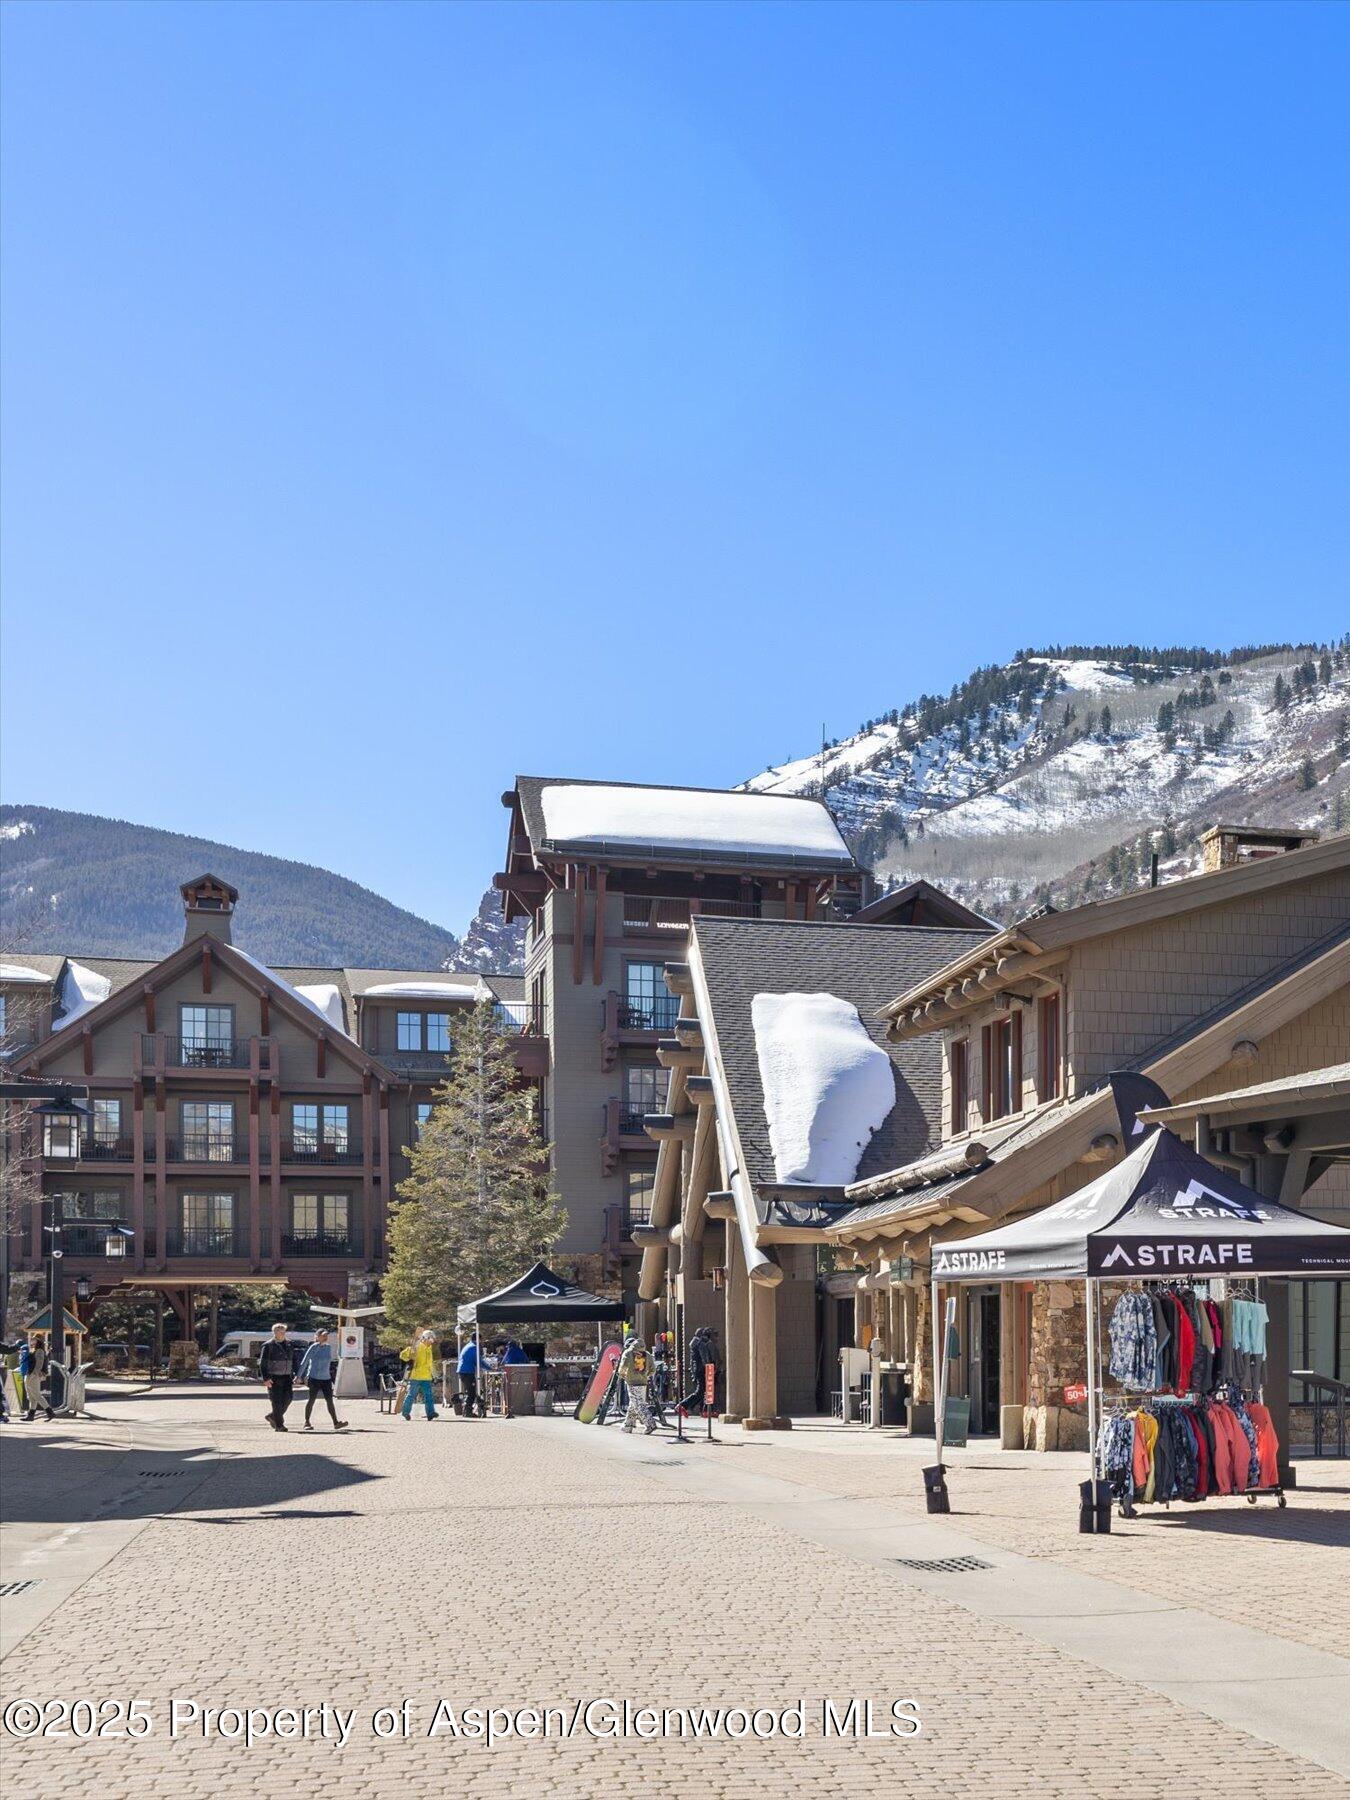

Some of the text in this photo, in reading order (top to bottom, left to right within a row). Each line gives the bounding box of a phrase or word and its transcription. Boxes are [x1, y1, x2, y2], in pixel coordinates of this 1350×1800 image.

[1158, 1207, 1273, 1220] STRAFE
[951, 1250, 1006, 1272] STRAFE
[1137, 1243, 1254, 1266] STRAFE
